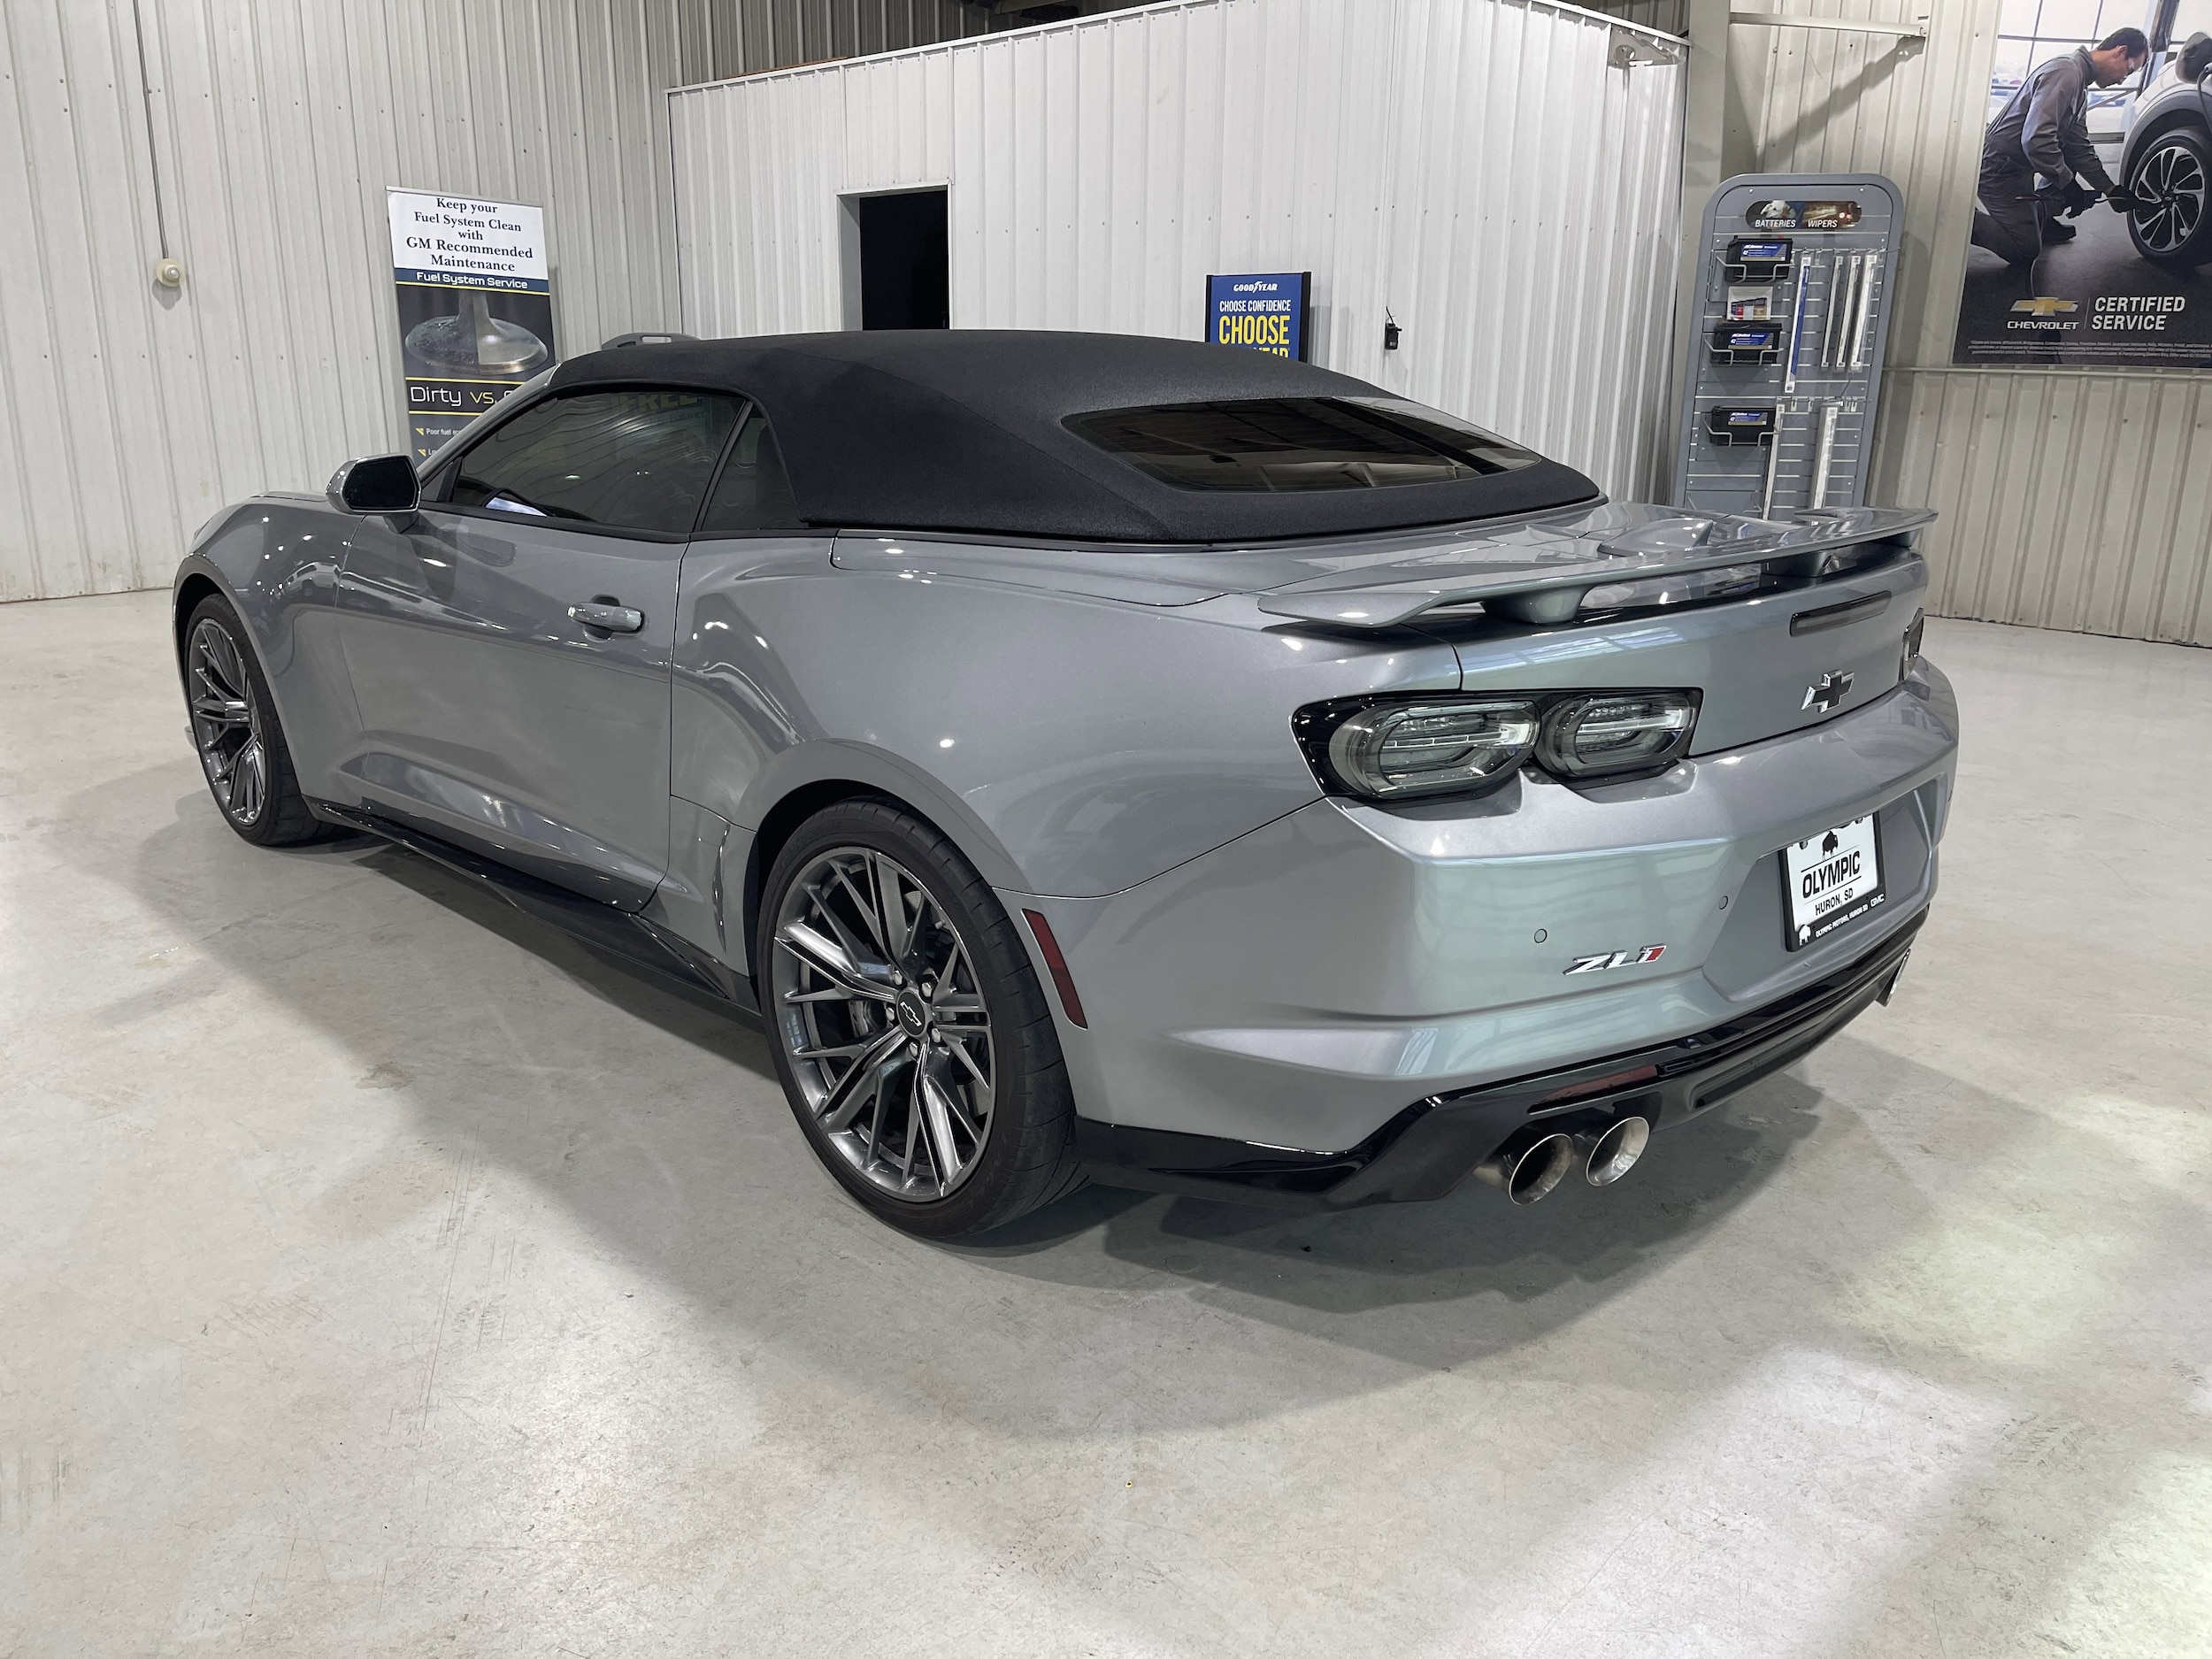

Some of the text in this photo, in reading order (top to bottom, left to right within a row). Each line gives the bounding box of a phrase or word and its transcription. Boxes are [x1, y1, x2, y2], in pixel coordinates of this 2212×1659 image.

[436, 197, 498, 214] Keep your
[414, 211, 522, 232] Fuel System Clean
[1755, 219, 1838, 228] BATTERIES WIPERS
[458, 229, 484, 241] with
[406, 236, 534, 258] GM Recommended
[430, 254, 516, 272] Maintenance
[416, 272, 528, 289] Fuel System Service
[1233, 280, 1279, 293] GOODYEAR
[1219, 300, 1292, 312] CHOOSE CONFIDENCE
[2094, 296, 2186, 312] CERTIFIED
[1218, 315, 1291, 345] CHOOSE
[2007, 320, 2079, 330] CHEVROLET
[2092, 315, 2168, 331] SERVICE
[410, 386, 462, 407] Dirty
[1802, 850, 1862, 899] OLYMPIC
[1815, 887, 1854, 916] HURON, SD
[1870, 893, 1886, 908] GMC
[1563, 942, 1667, 976] ZL1
